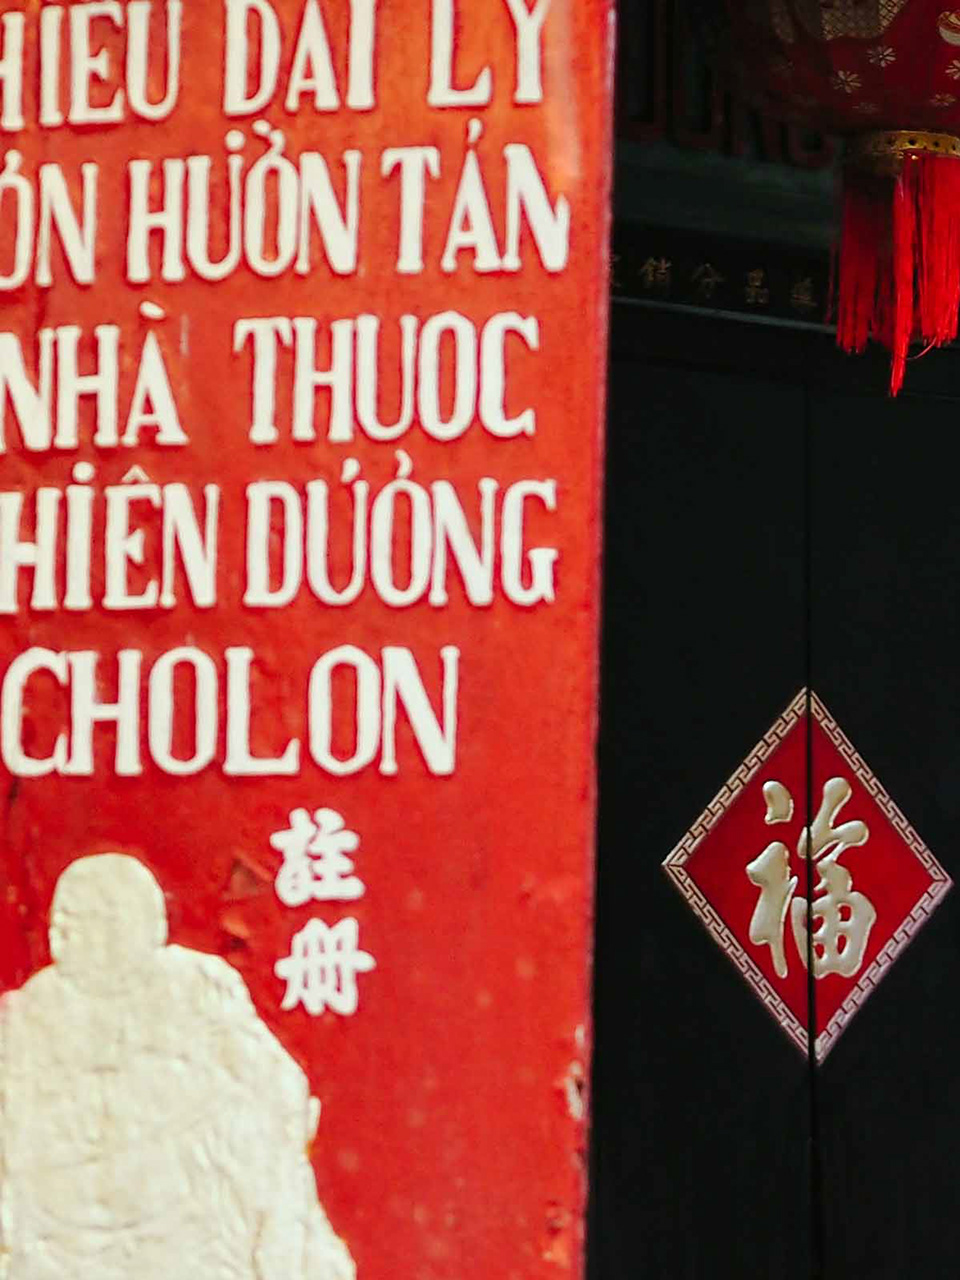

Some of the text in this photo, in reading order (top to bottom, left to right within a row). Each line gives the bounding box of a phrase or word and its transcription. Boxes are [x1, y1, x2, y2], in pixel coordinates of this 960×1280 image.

[0, 302, 538, 451] NHÀ THUOC
[2, 645, 459, 776] CHOLON
[746, 776, 877, 980] 福
